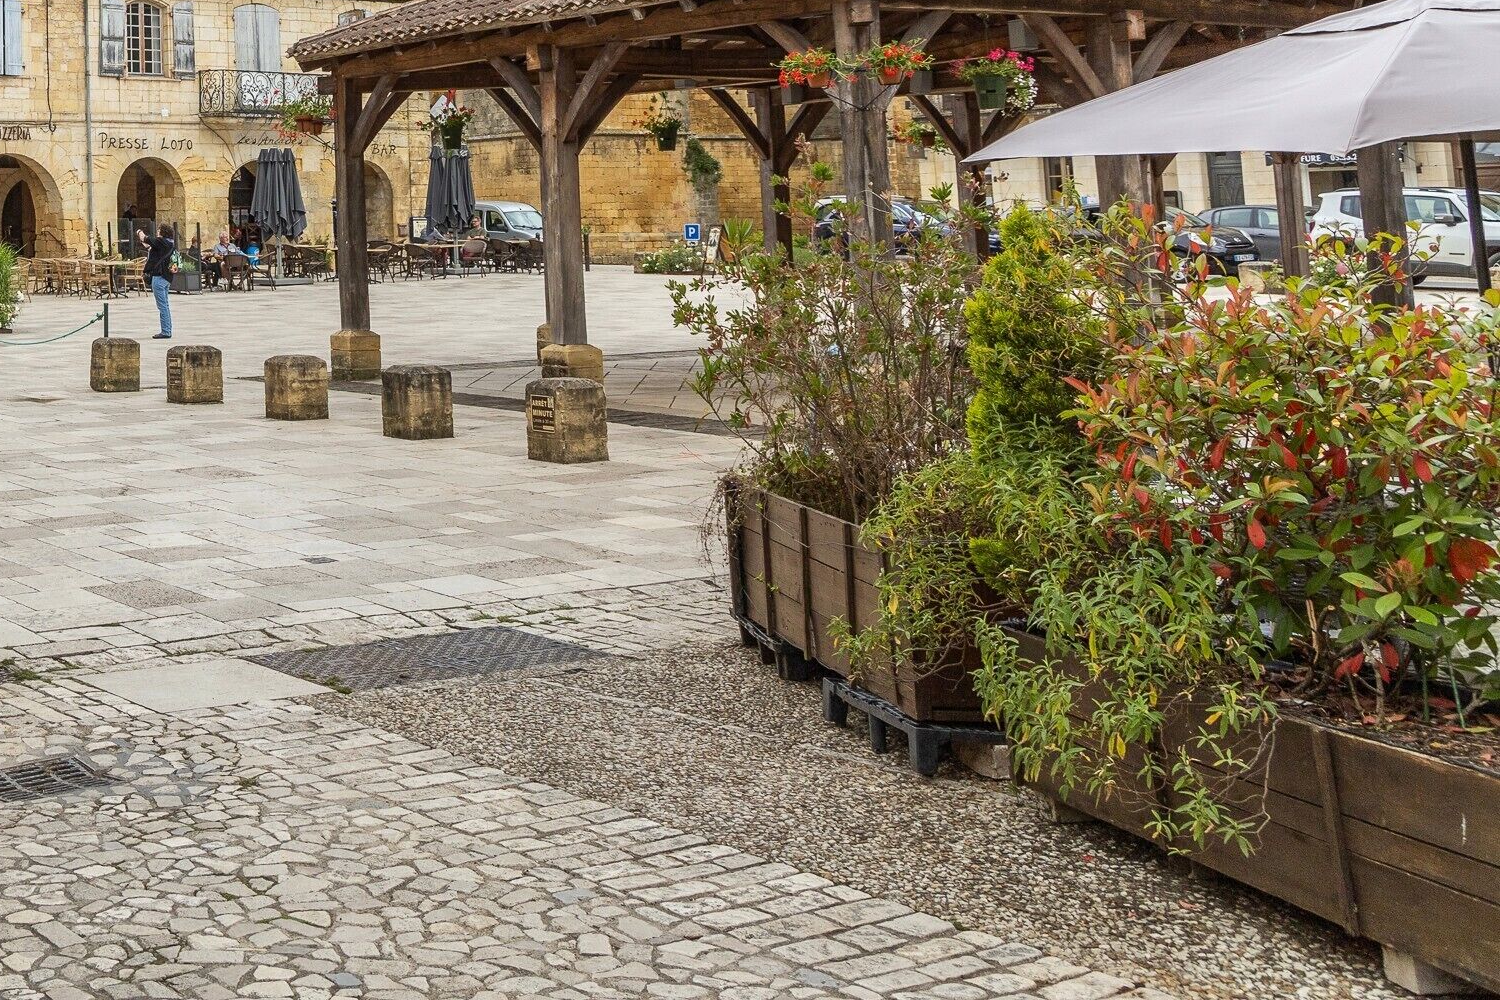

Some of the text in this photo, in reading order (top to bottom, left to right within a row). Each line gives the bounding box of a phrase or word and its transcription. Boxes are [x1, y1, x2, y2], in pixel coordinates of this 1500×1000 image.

[99, 132, 193, 151] PRESSE LOTO
[371, 143, 397, 157] BAR
[688, 226, 696, 238] P
[532, 408, 553, 418] MINUTE
